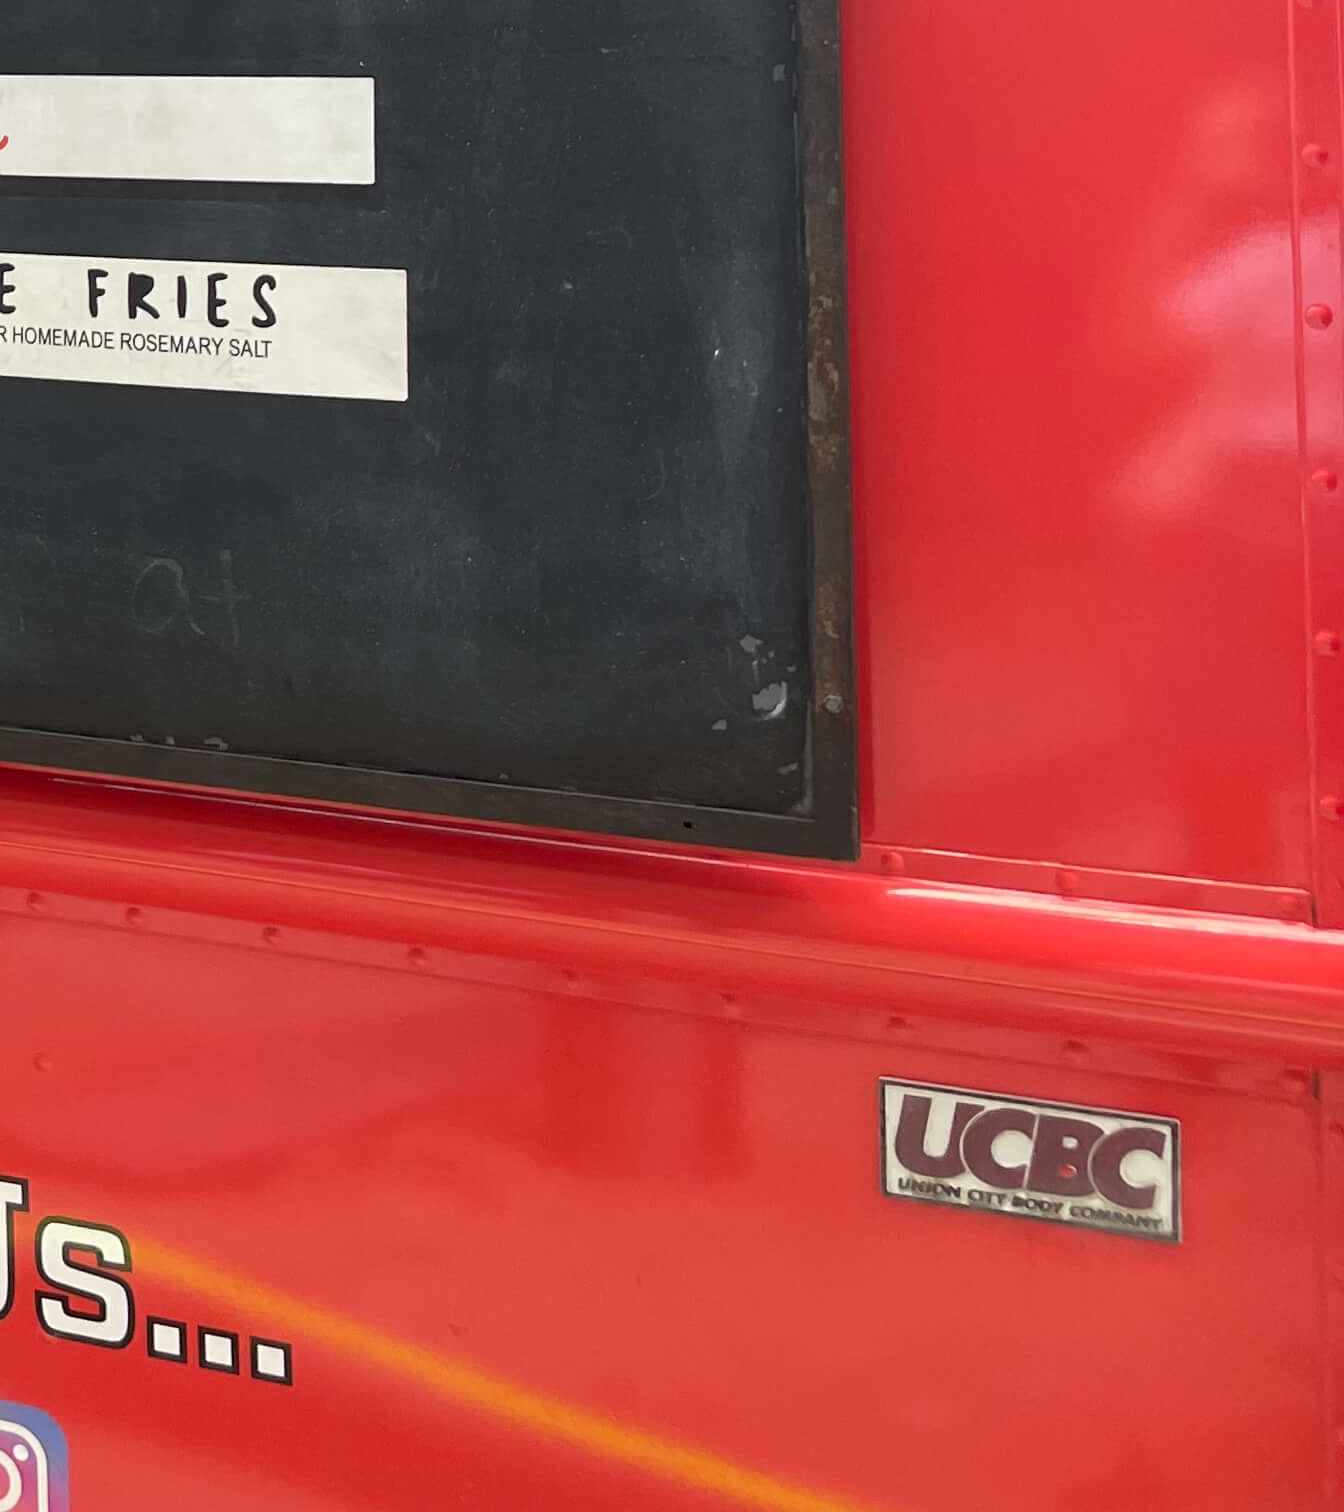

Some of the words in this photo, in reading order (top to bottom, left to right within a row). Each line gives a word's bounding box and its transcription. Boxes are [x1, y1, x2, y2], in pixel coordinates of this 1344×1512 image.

[87, 267, 277, 329] FRIES
[12, 325, 114, 350] HOMEMADE
[120, 330, 224, 355] ROSEMARY
[229, 336, 273, 358] SALT
[895, 1093, 1167, 1210] UCBC
[897, 1177, 962, 1199] UNION
[968, 1189, 1007, 1206] CITY
[1012, 1195, 1064, 1215] BODY
[1070, 1204, 1163, 1230] COMPANY
